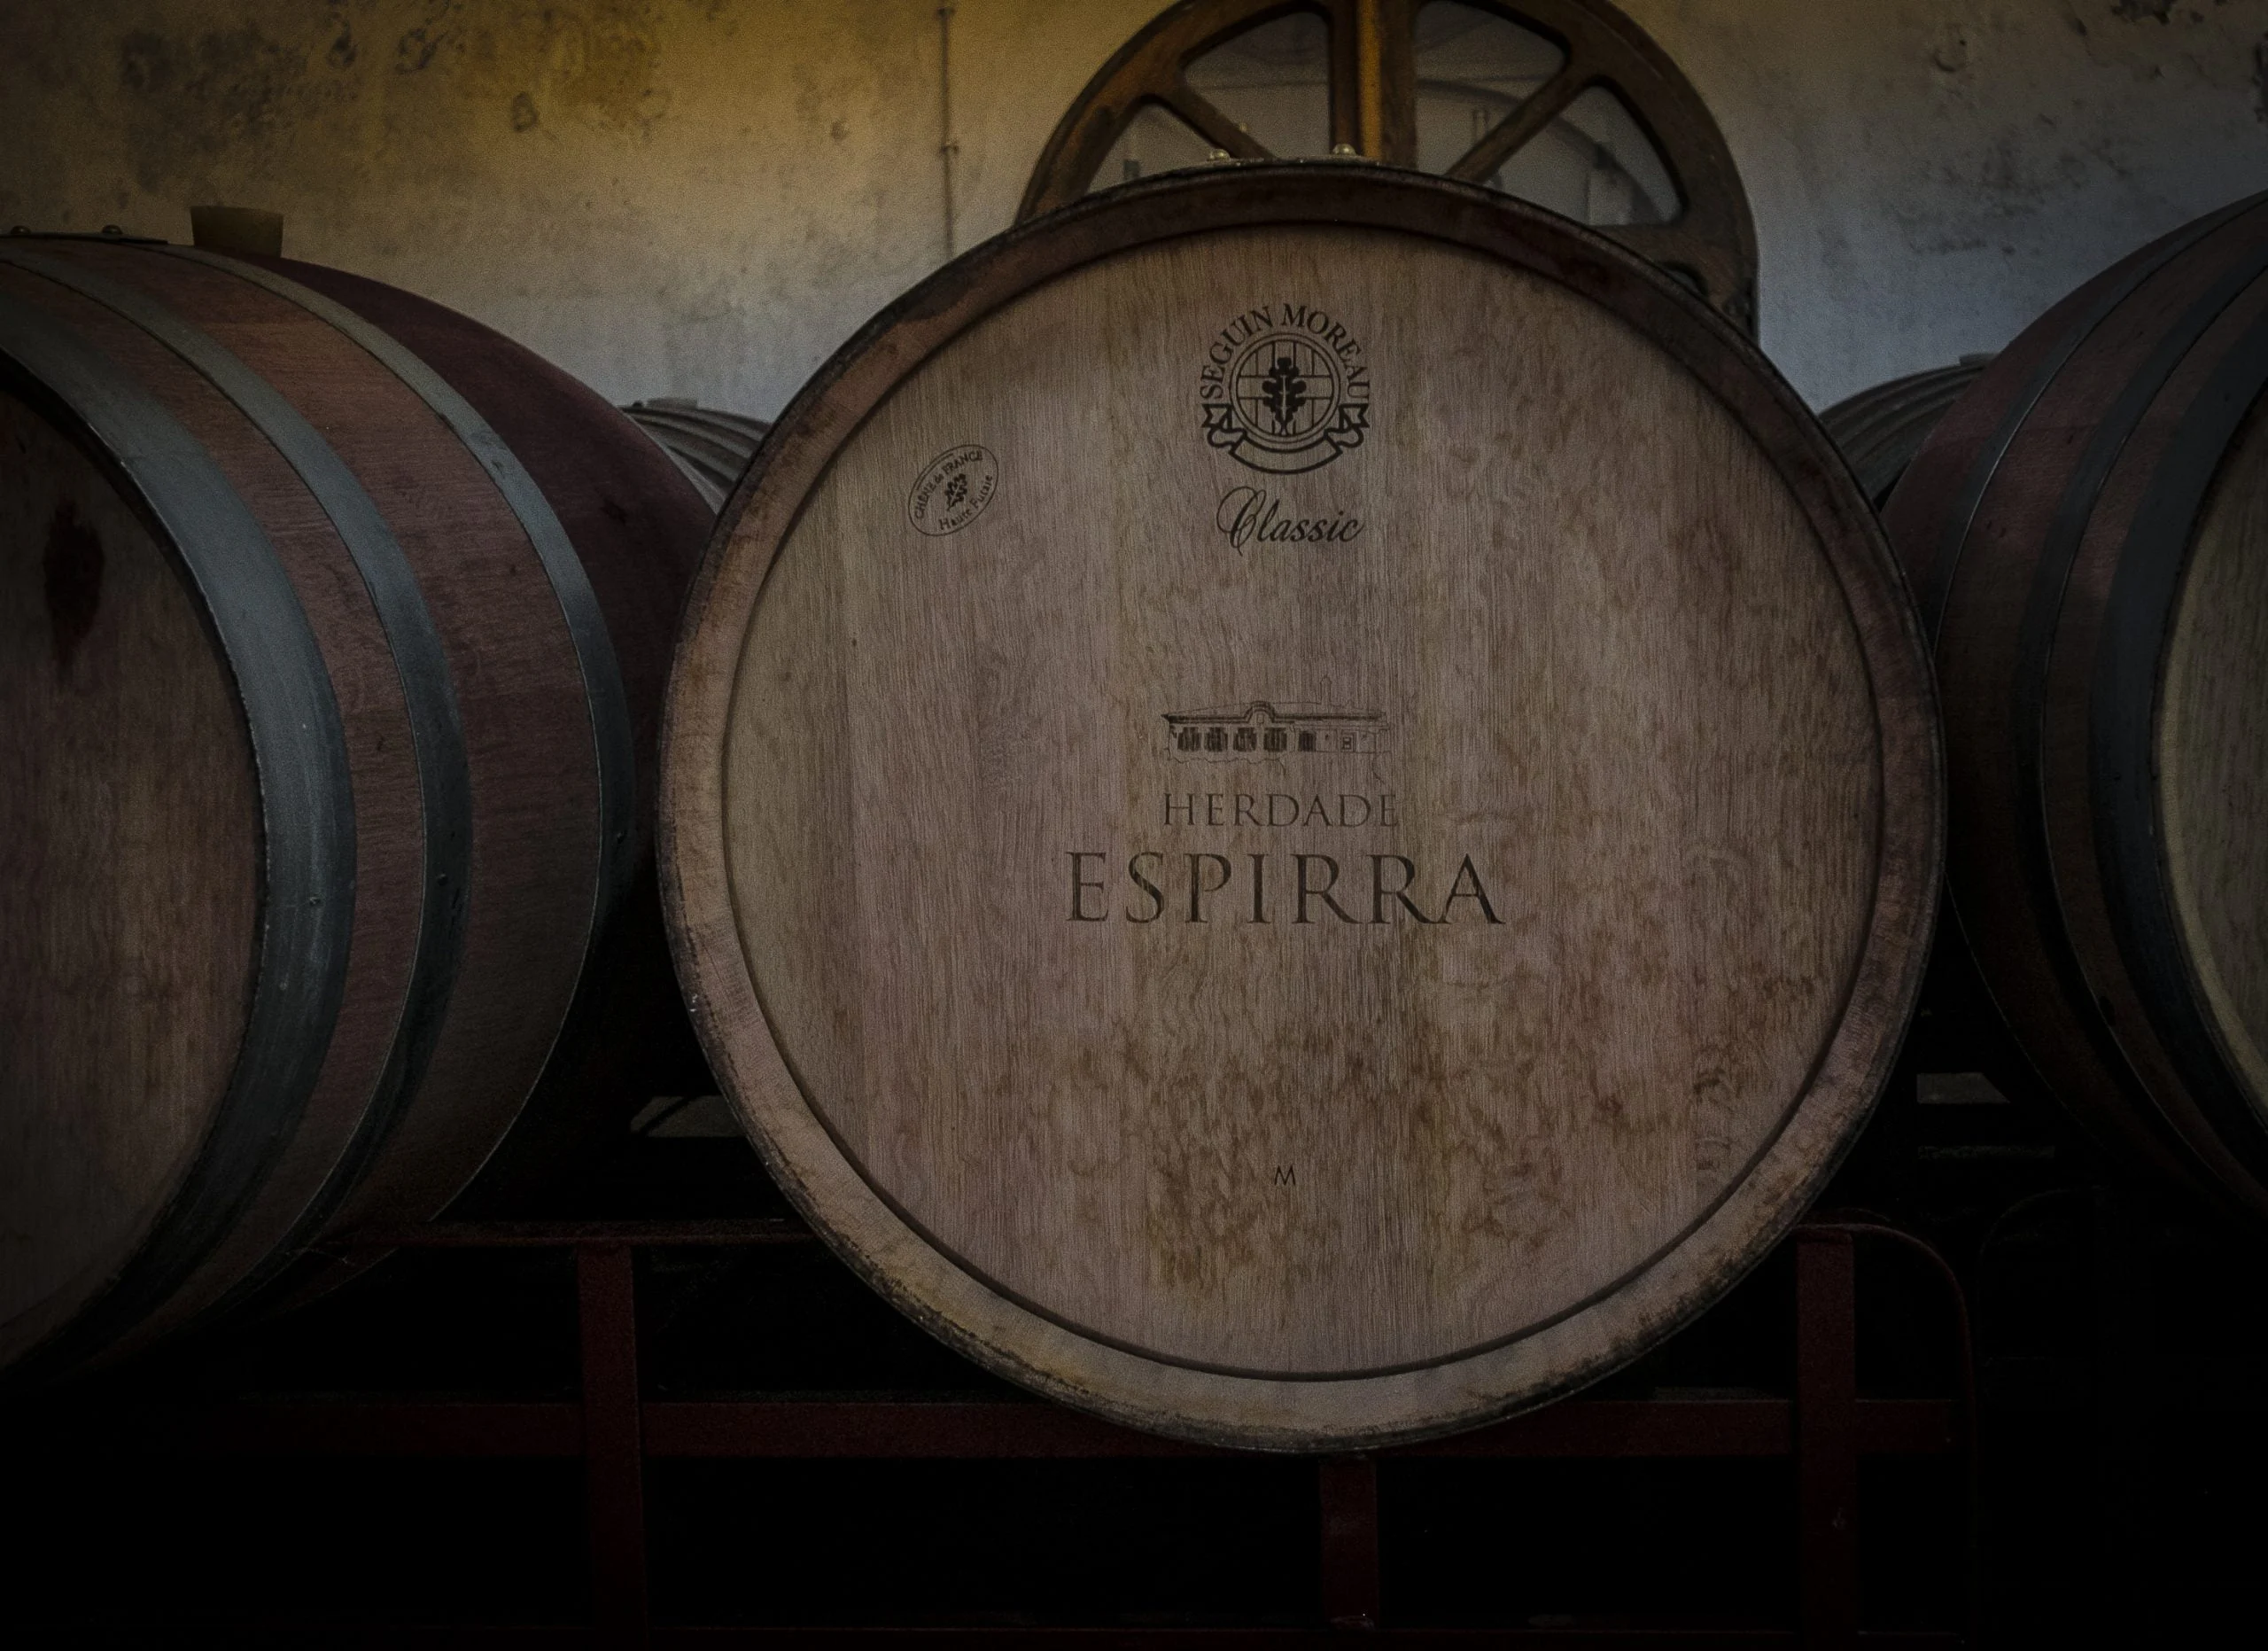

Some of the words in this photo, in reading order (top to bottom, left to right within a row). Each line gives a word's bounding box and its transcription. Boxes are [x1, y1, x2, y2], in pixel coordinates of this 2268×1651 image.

[1200, 307, 1273, 399] SEGUIN
[1281, 303, 1370, 399] MOREAU
[941, 450, 983, 475] FRANCE
[1216, 487, 1365, 557] Classic
[1163, 793, 1398, 828] HERDADE
[1066, 851, 1506, 924] ESPIRRA
[1274, 1165, 1296, 1186] M
